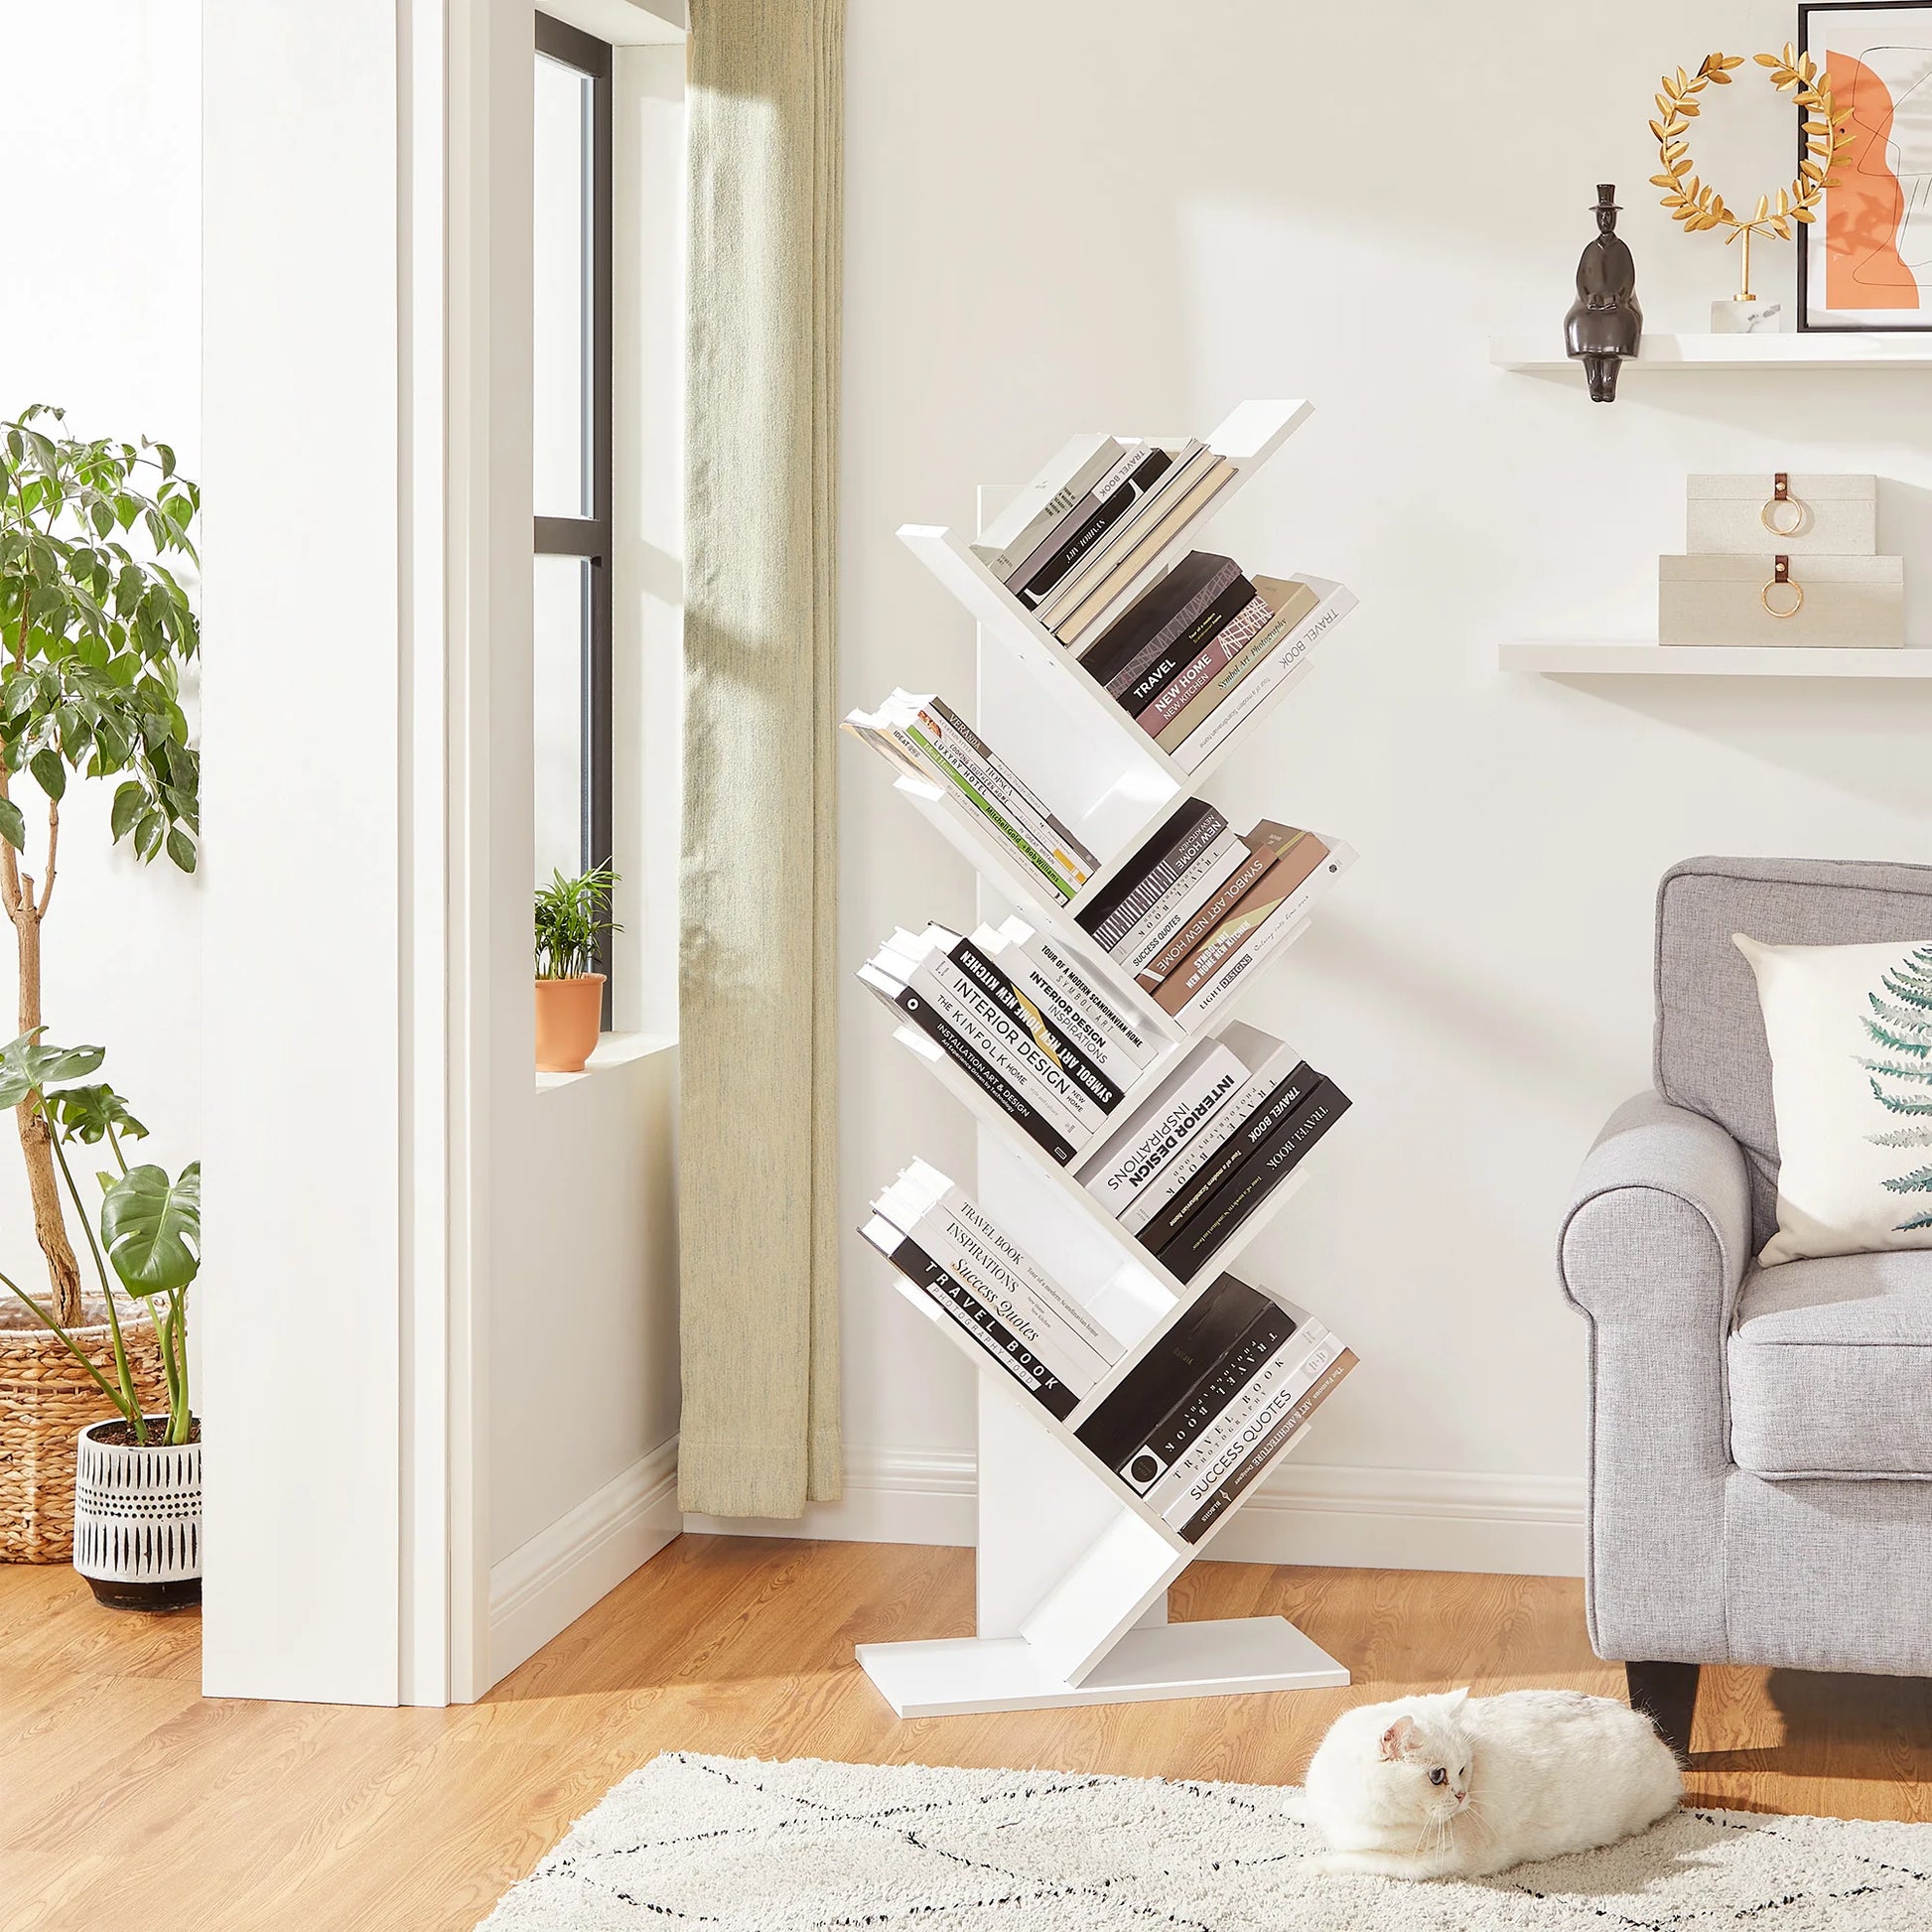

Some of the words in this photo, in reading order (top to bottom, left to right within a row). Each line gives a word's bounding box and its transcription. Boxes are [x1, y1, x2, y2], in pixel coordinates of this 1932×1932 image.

[1118, 450, 1145, 475] TRAVEL
[1099, 474, 1120, 496] BOOK
[1302, 608, 1339, 641] TRAVEL
[1217, 664, 1240, 690] Symbol
[1239, 655, 1250, 668] Art
[1250, 617, 1286, 656] Photography
[1278, 640, 1305, 669] BOOK
[1133, 659, 1176, 698] TRAVEL
[1154, 683, 1180, 712] NEW
[1178, 653, 1212, 688] HOME
[1162, 700, 1180, 720] NEW
[1178, 672, 1209, 707] KITCHEN
[1259, 676, 1270, 687] Tour
[1236, 690, 1255, 710] modern
[948, 713, 982, 750] VERANDA
[1198, 734, 1212, 748] home
[933, 739, 962, 768] LUXYRY
[963, 770, 986, 795] HOTEL
[994, 789, 1008, 803] HOME
[1178, 827, 1202, 853] KITCHEN
[1200, 814, 1214, 830] NEW
[1200, 820, 1221, 843] NEW
[985, 805, 1009, 831] Mitchell
[1006, 826, 1024, 843] Gold
[1036, 857, 1060, 883] Williams
[1174, 840, 1202, 869] HOME
[1174, 852, 1218, 896] TRAVEL
[1223, 859, 1265, 898] SYMBOL
[1137, 904, 1169, 935] BOOK
[1207, 896, 1225, 920] ART
[1132, 937, 1159, 966] SUCCESS
[1157, 914, 1181, 940] QUOTES
[1185, 916, 1209, 943] NEW
[1193, 939, 1219, 968] SYMBOL
[1213, 927, 1232, 945] ART
[959, 950, 999, 990] KITCHEN
[1155, 939, 1187, 971] HOME
[1185, 972, 1200, 988] NEW
[1197, 956, 1217, 976] HOME
[1213, 943, 1228, 959] NEW
[1224, 918, 1254, 947] KITCHEN
[995, 986, 1021, 1009] NEW
[1041, 944, 1057, 962] TOUR
[1055, 959, 1065, 969] OF
[1062, 967, 1070, 975] A
[1067, 971, 1091, 996] MODERN
[1089, 993, 1128, 1032] SCANDINAVIAN
[1125, 1029, 1143, 1047] HOME
[1199, 986, 1221, 1009] LIGHT
[1218, 953, 1252, 987] DESIGNS
[1013, 1000, 1045, 1036] HOME
[1029, 971, 1072, 1015] INTERIOR
[1070, 1012, 1106, 1048] DESIGN
[1055, 975, 1091, 1012] SYMBOL
[1094, 1014, 1113, 1032] ART
[937, 994, 953, 1011] THE
[951, 1009, 1007, 1066] KINFOLK
[1005, 1063, 1027, 1085] HOME
[953, 978, 1018, 1044] INTERIOR
[1016, 1041, 1070, 1094] DESIGN
[1034, 1025, 1061, 1055] NEW
[1047, 1003, 1107, 1064] INSPIRATIONS
[936, 1023, 985, 1072] INSTALLATION
[982, 1070, 999, 1084] ART
[995, 1083, 1004, 1092] &
[1002, 1089, 1029, 1117] DESIGN
[1053, 1047, 1079, 1068] ART
[983, 1080, 991, 1089] by
[1071, 1089, 1085, 1103] NEW
[1076, 1064, 1112, 1102] SYMBOL
[1269, 1086, 1300, 1117] TRAVEL
[1066, 1095, 1083, 1112] HOME
[1173, 1074, 1234, 1137] INTERIOR
[1198, 1087, 1256, 1148] PHOTOGRAPHY
[1216, 1079, 1275, 1140] TRAVEL
[1291, 1106, 1328, 1140] TRAVEL
[1107, 1102, 1189, 1190] INSPIRATIONS
[1247, 1115, 1272, 1142] BOOK
[1128, 1135, 1178, 1187] DESIGN
[1165, 1152, 1207, 1193] BOOK
[1173, 1153, 1194, 1176] FOOD
[1230, 1149, 1241, 1161] Tour
[1266, 1140, 1294, 1170] BOOK
[1206, 1167, 1223, 1185] modern
[960, 1201, 994, 1239] TRAVEL
[994, 1235, 1023, 1264] BOOK
[1169, 1212, 1183, 1226] home
[946, 1222, 1018, 1292] INSPIRATIONS
[1027, 1267, 1038, 1278] Tour
[951, 1258, 998, 1302] Success
[996, 1300, 1038, 1341] Quotes
[925, 1261, 995, 1332] TRAVEL
[1006, 1339, 1058, 1389] BOOK
[931, 1286, 1004, 1355] PHOTOGRAPHY
[1006, 1358, 1033, 1383] FOOD
[1184, 1340, 1256, 1417] PHOTOGRAPHY
[1215, 1332, 1277, 1394] TRAVEL
[1331, 1366, 1344, 1378] The
[1172, 1416, 1233, 1478] TRAVEL
[1241, 1361, 1283, 1403] BOOK
[1292, 1410, 1302, 1419] &
[1298, 1398, 1312, 1415] ART
[1164, 1406, 1207, 1451] BOOK
[1190, 1441, 1244, 1500] SUCCESS
[1242, 1389, 1291, 1442] QUOTES
[1193, 1391, 1266, 1470] PHOTOGRAPHY
[1251, 1415, 1300, 1466] ARCHITECTURE
